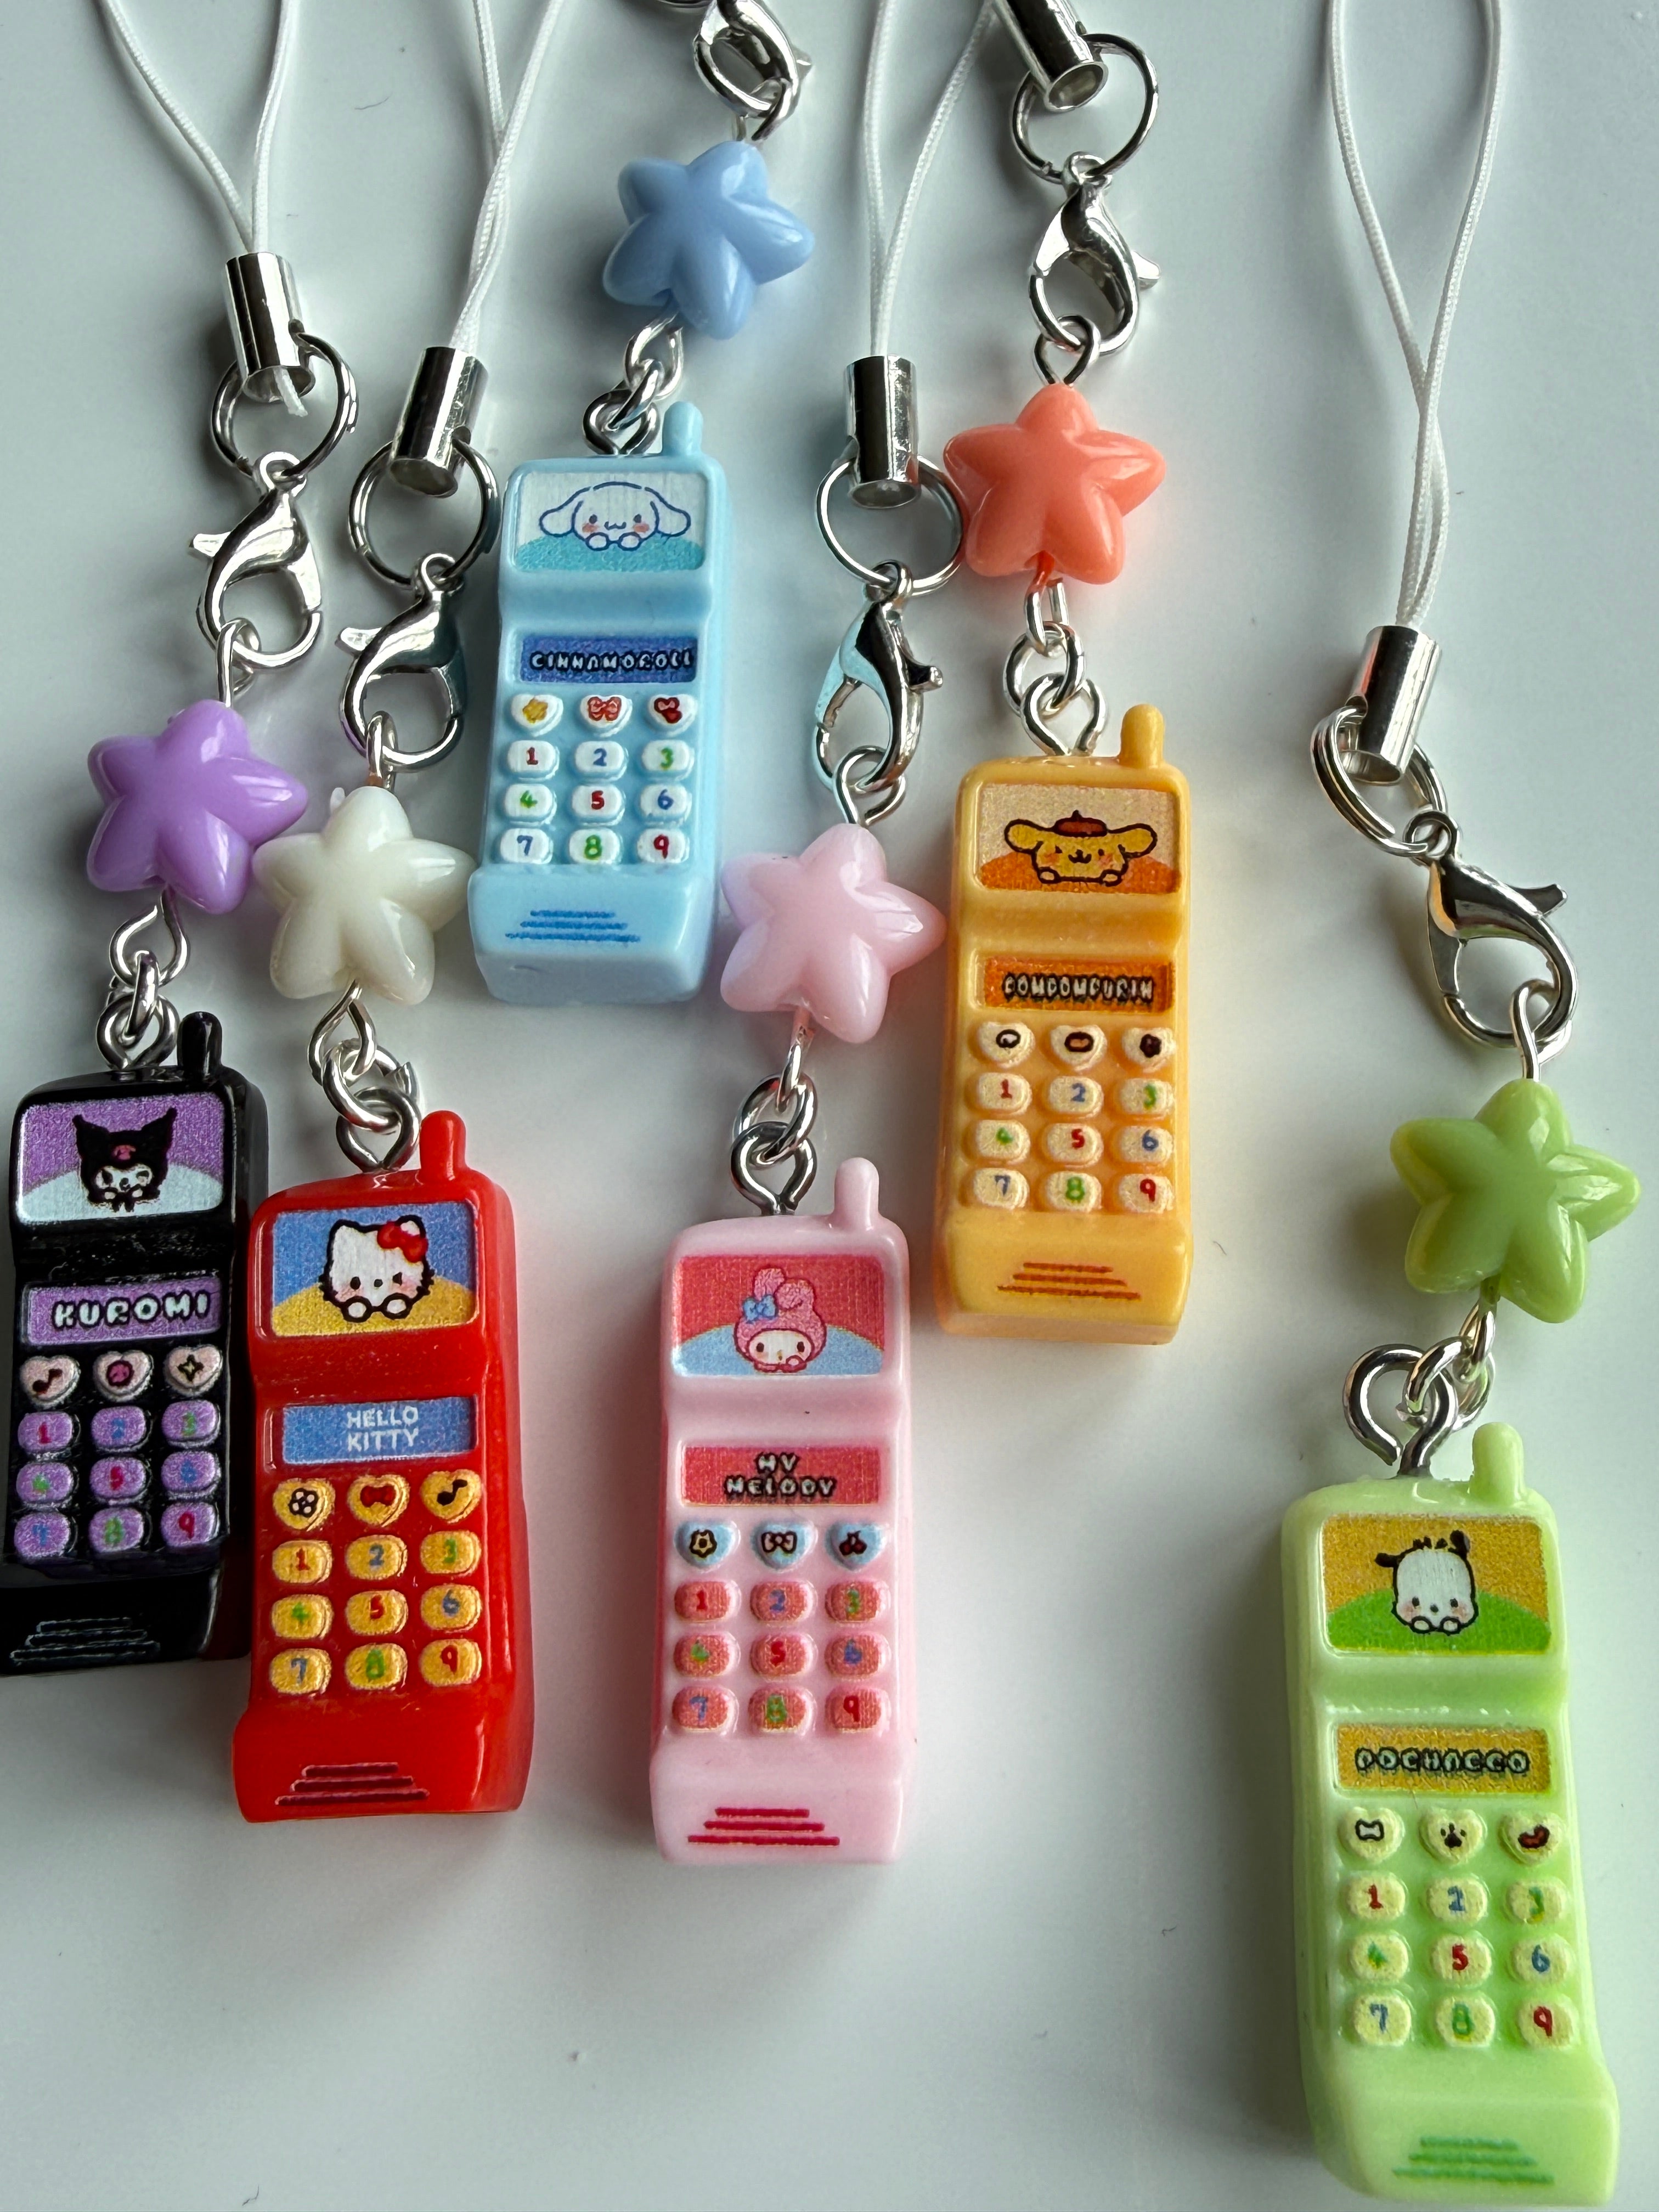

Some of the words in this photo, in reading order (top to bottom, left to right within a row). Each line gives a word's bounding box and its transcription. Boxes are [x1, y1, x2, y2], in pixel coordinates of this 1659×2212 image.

[526, 747, 539, 765] 1
[594, 748, 607, 766] 2
[661, 747, 674, 770] 3
[591, 790, 605, 810] 5
[657, 789, 674, 810] 6
[517, 834, 533, 856] 7
[584, 834, 602, 860] 8
[653, 834, 669, 859] 9
[1001, 1079, 1012, 1098] 1
[1071, 1082, 1086, 1103] 2
[1143, 1084, 1157, 1109] 3
[1071, 1128, 1085, 1149] 5
[1142, 1130, 1159, 1152] 6
[995, 1175, 1011, 1197] 7
[1065, 1176, 1086, 1203] 8
[1140, 1178, 1156, 1203] 9
[53, 1293, 210, 1330] KUROMI
[347, 1405, 419, 1429] HELLO
[38, 1421, 50, 1444] 1
[347, 1427, 419, 1453] KITTY
[755, 1452, 800, 1474] MY
[724, 1475, 837, 1498] MELODY
[178, 1511, 195, 1539] 9
[296, 1548, 310, 1571] 1
[369, 1544, 385, 1567] 2
[443, 1538, 458, 1564] 3
[370, 1595, 385, 1620] 5
[443, 1590, 461, 1616] 6
[696, 1590, 708, 1611] 1
[769, 1590, 786, 1612] 2
[846, 1588, 861, 1614] 3
[291, 1656, 307, 1684] 7
[365, 1649, 385, 1680] 8
[440, 1645, 459, 1674] 9
[770, 1641, 786, 1666] 5
[843, 1638, 862, 1666] 6
[690, 1695, 707, 1722] 7
[766, 1694, 788, 1724] 8
[843, 1695, 861, 1722] 9
[1368, 1883, 1384, 1909] 1
[1448, 1885, 1466, 1912] 2
[1528, 1886, 1544, 1922] 3
[1451, 1943, 1468, 1971] 5
[1531, 1944, 1551, 1973] 6
[1369, 2002, 1389, 2033] 7
[1451, 2002, 1474, 2040] 8
[1533, 2005, 1553, 2037] 9
